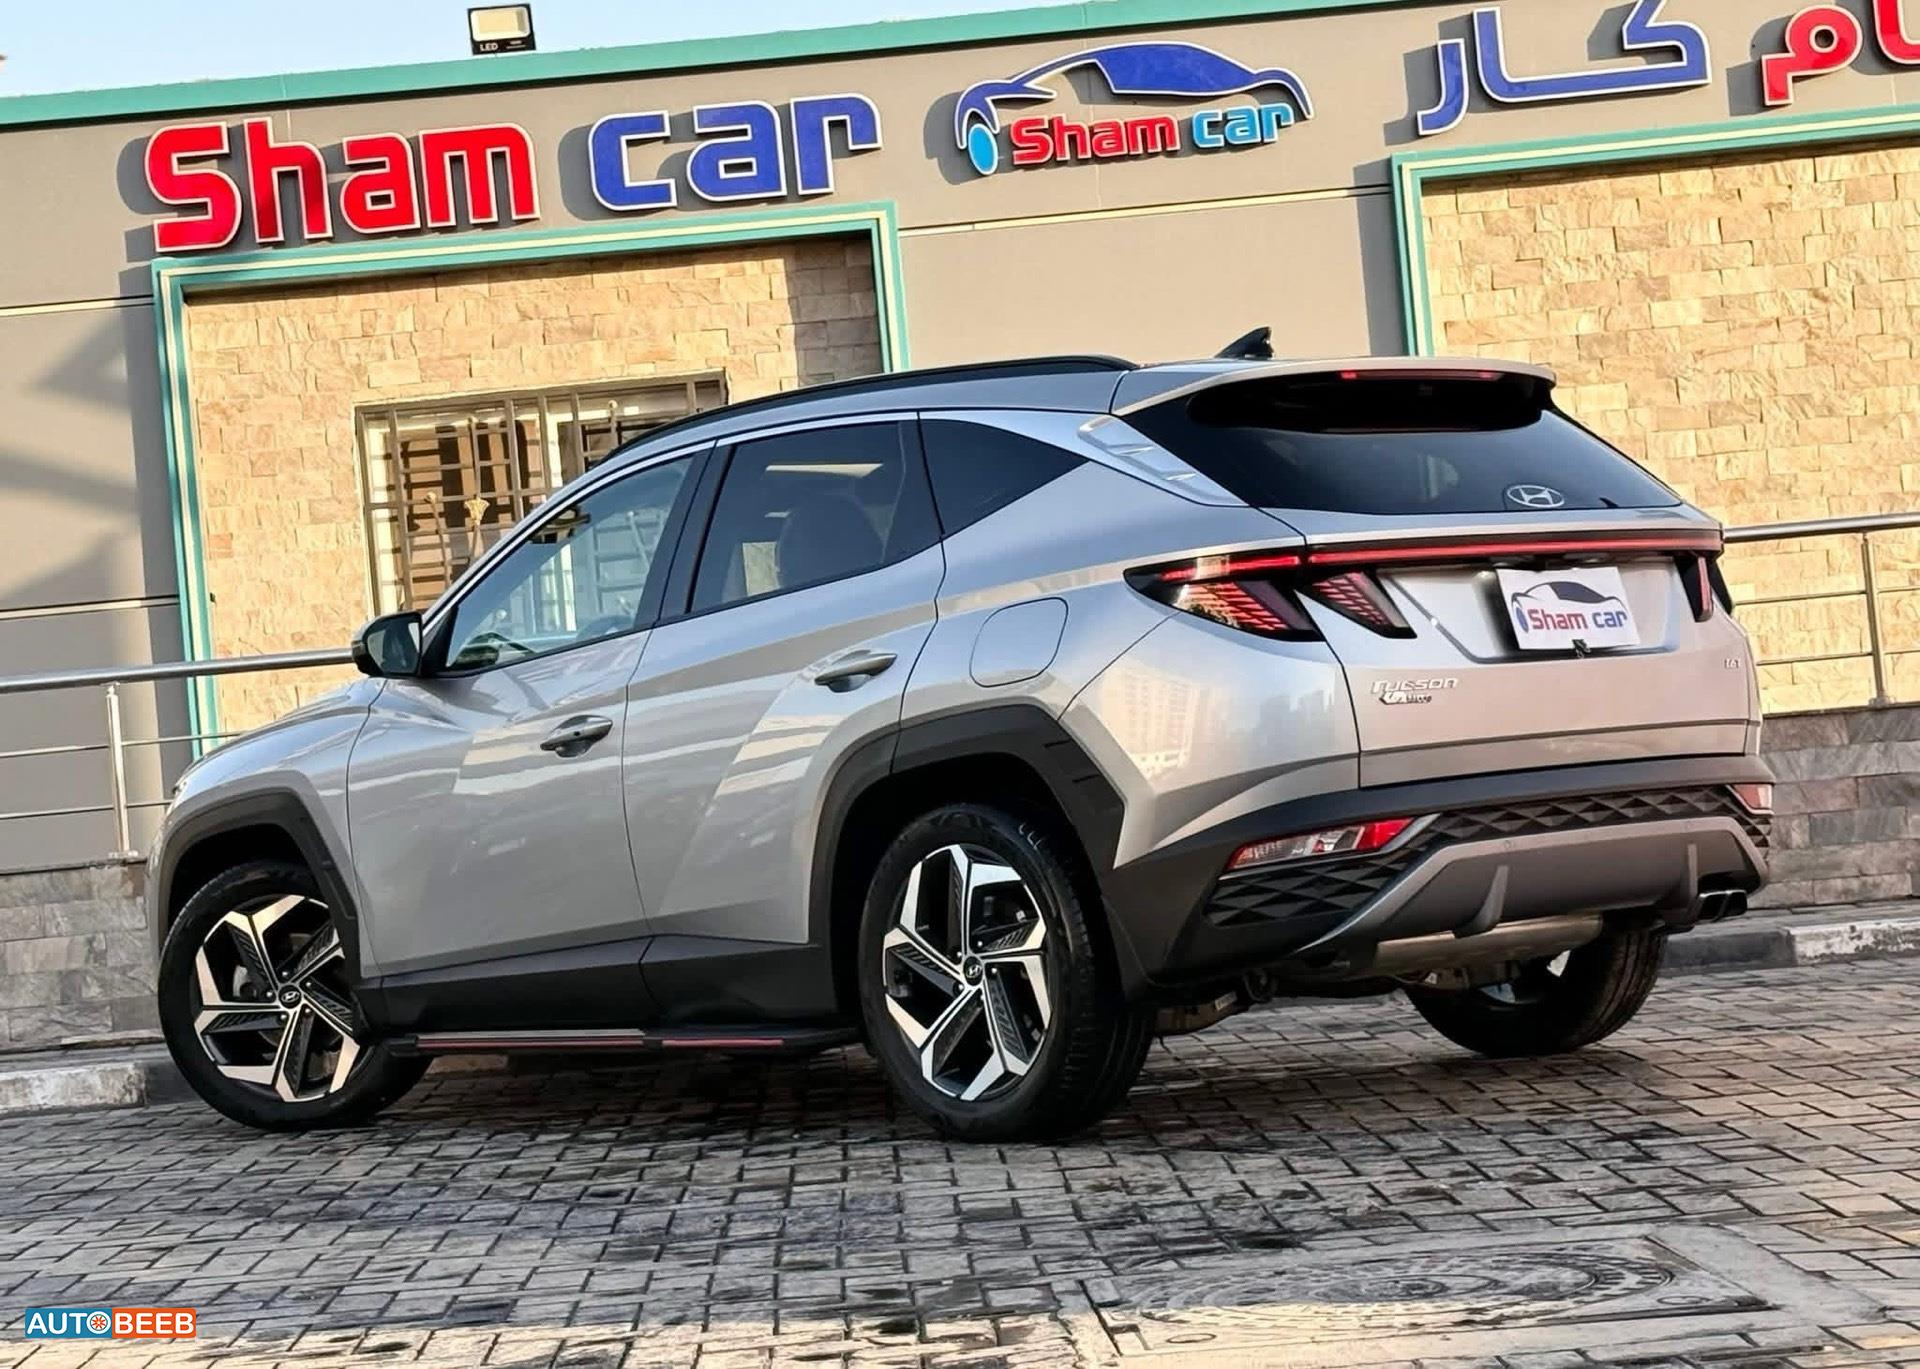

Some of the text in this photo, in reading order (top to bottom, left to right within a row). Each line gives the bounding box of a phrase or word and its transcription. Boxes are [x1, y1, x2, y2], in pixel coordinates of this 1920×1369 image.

[480, 42, 499, 52] LED
[1417, 0, 1711, 136] كار
[1010, 101, 1294, 165] Sham car
[145, 93, 883, 253] Sham car
[1527, 608, 1628, 631] Sham car
